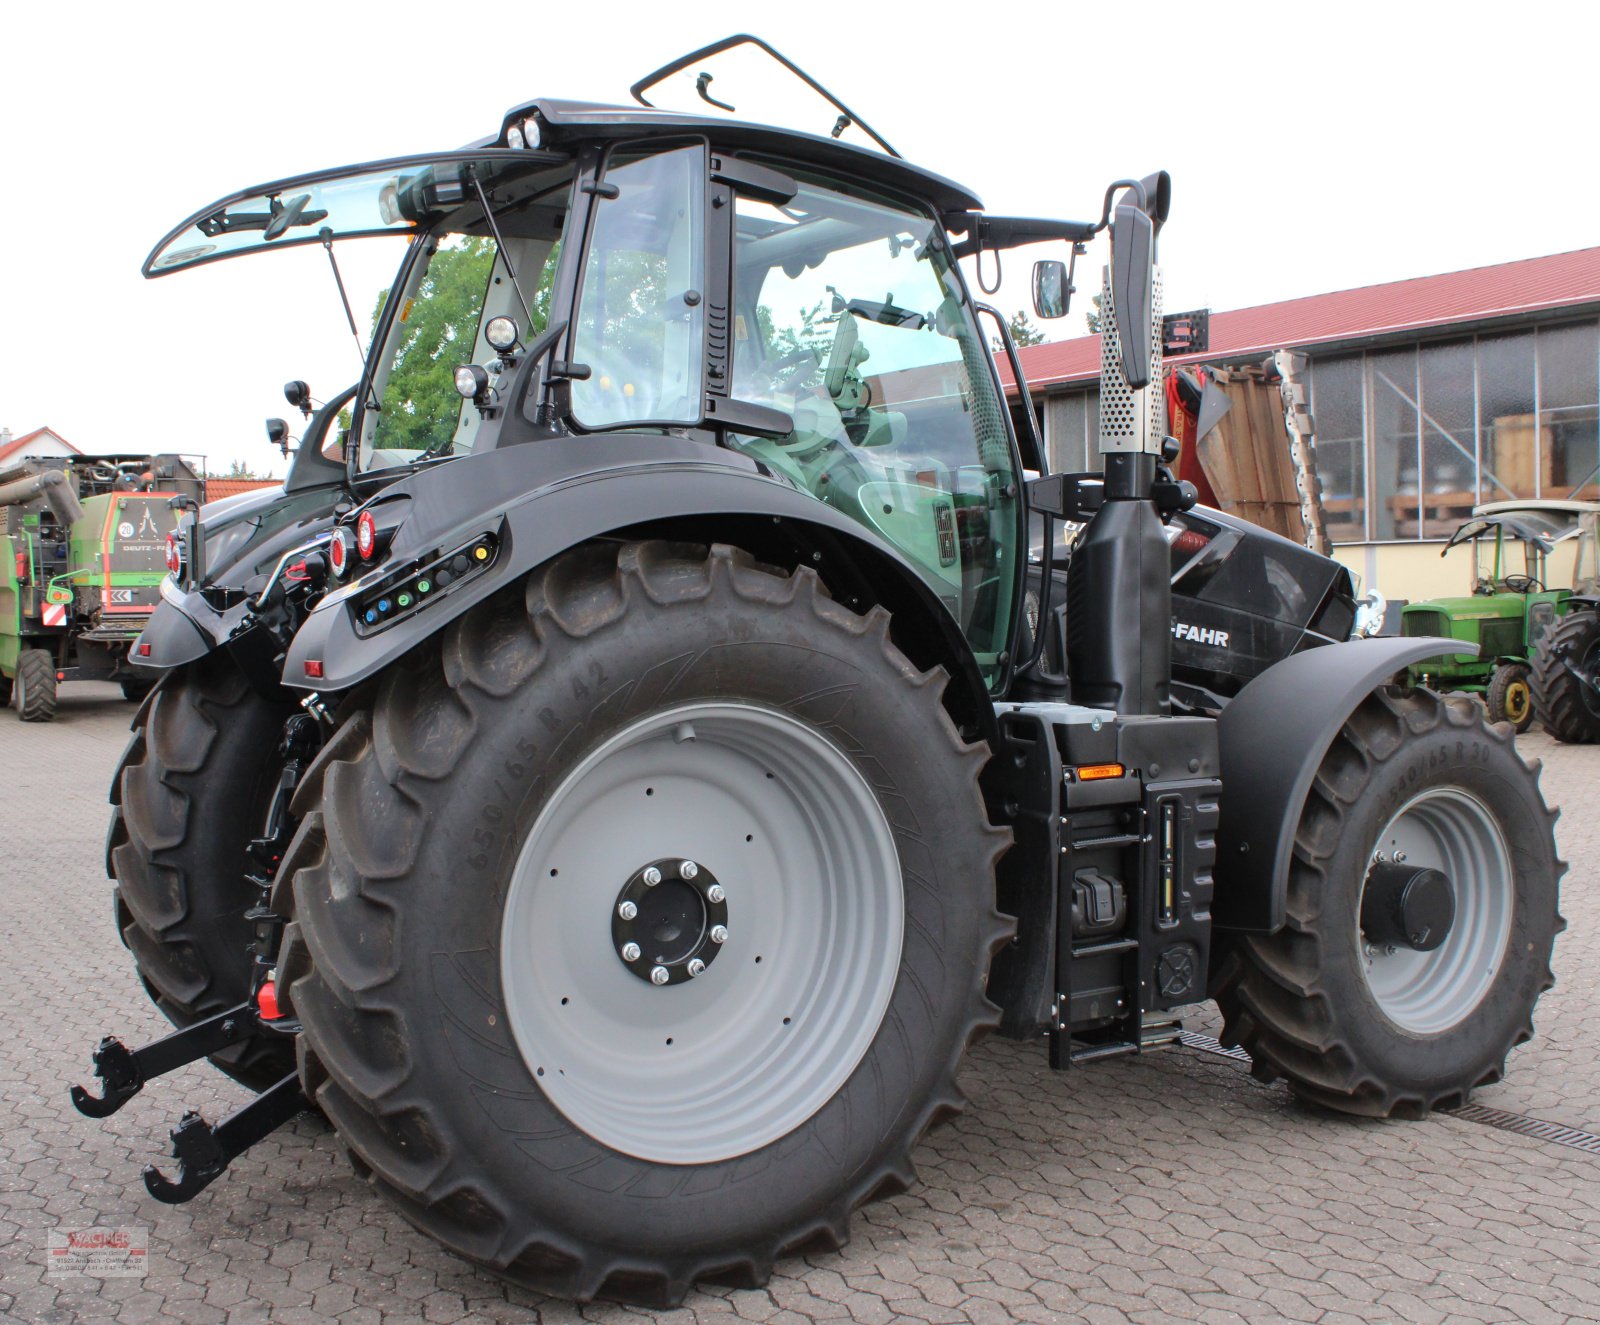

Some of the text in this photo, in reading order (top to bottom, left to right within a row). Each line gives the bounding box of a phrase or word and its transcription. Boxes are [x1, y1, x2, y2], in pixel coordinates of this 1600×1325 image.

[121, 525, 132, 535] 20
[1171, 623, 1229, 648] -FAHR
[537, 707, 563, 732] R
[571, 661, 609, 702] 42
[1455, 741, 1465, 761] R
[1471, 741, 1491, 762] 30
